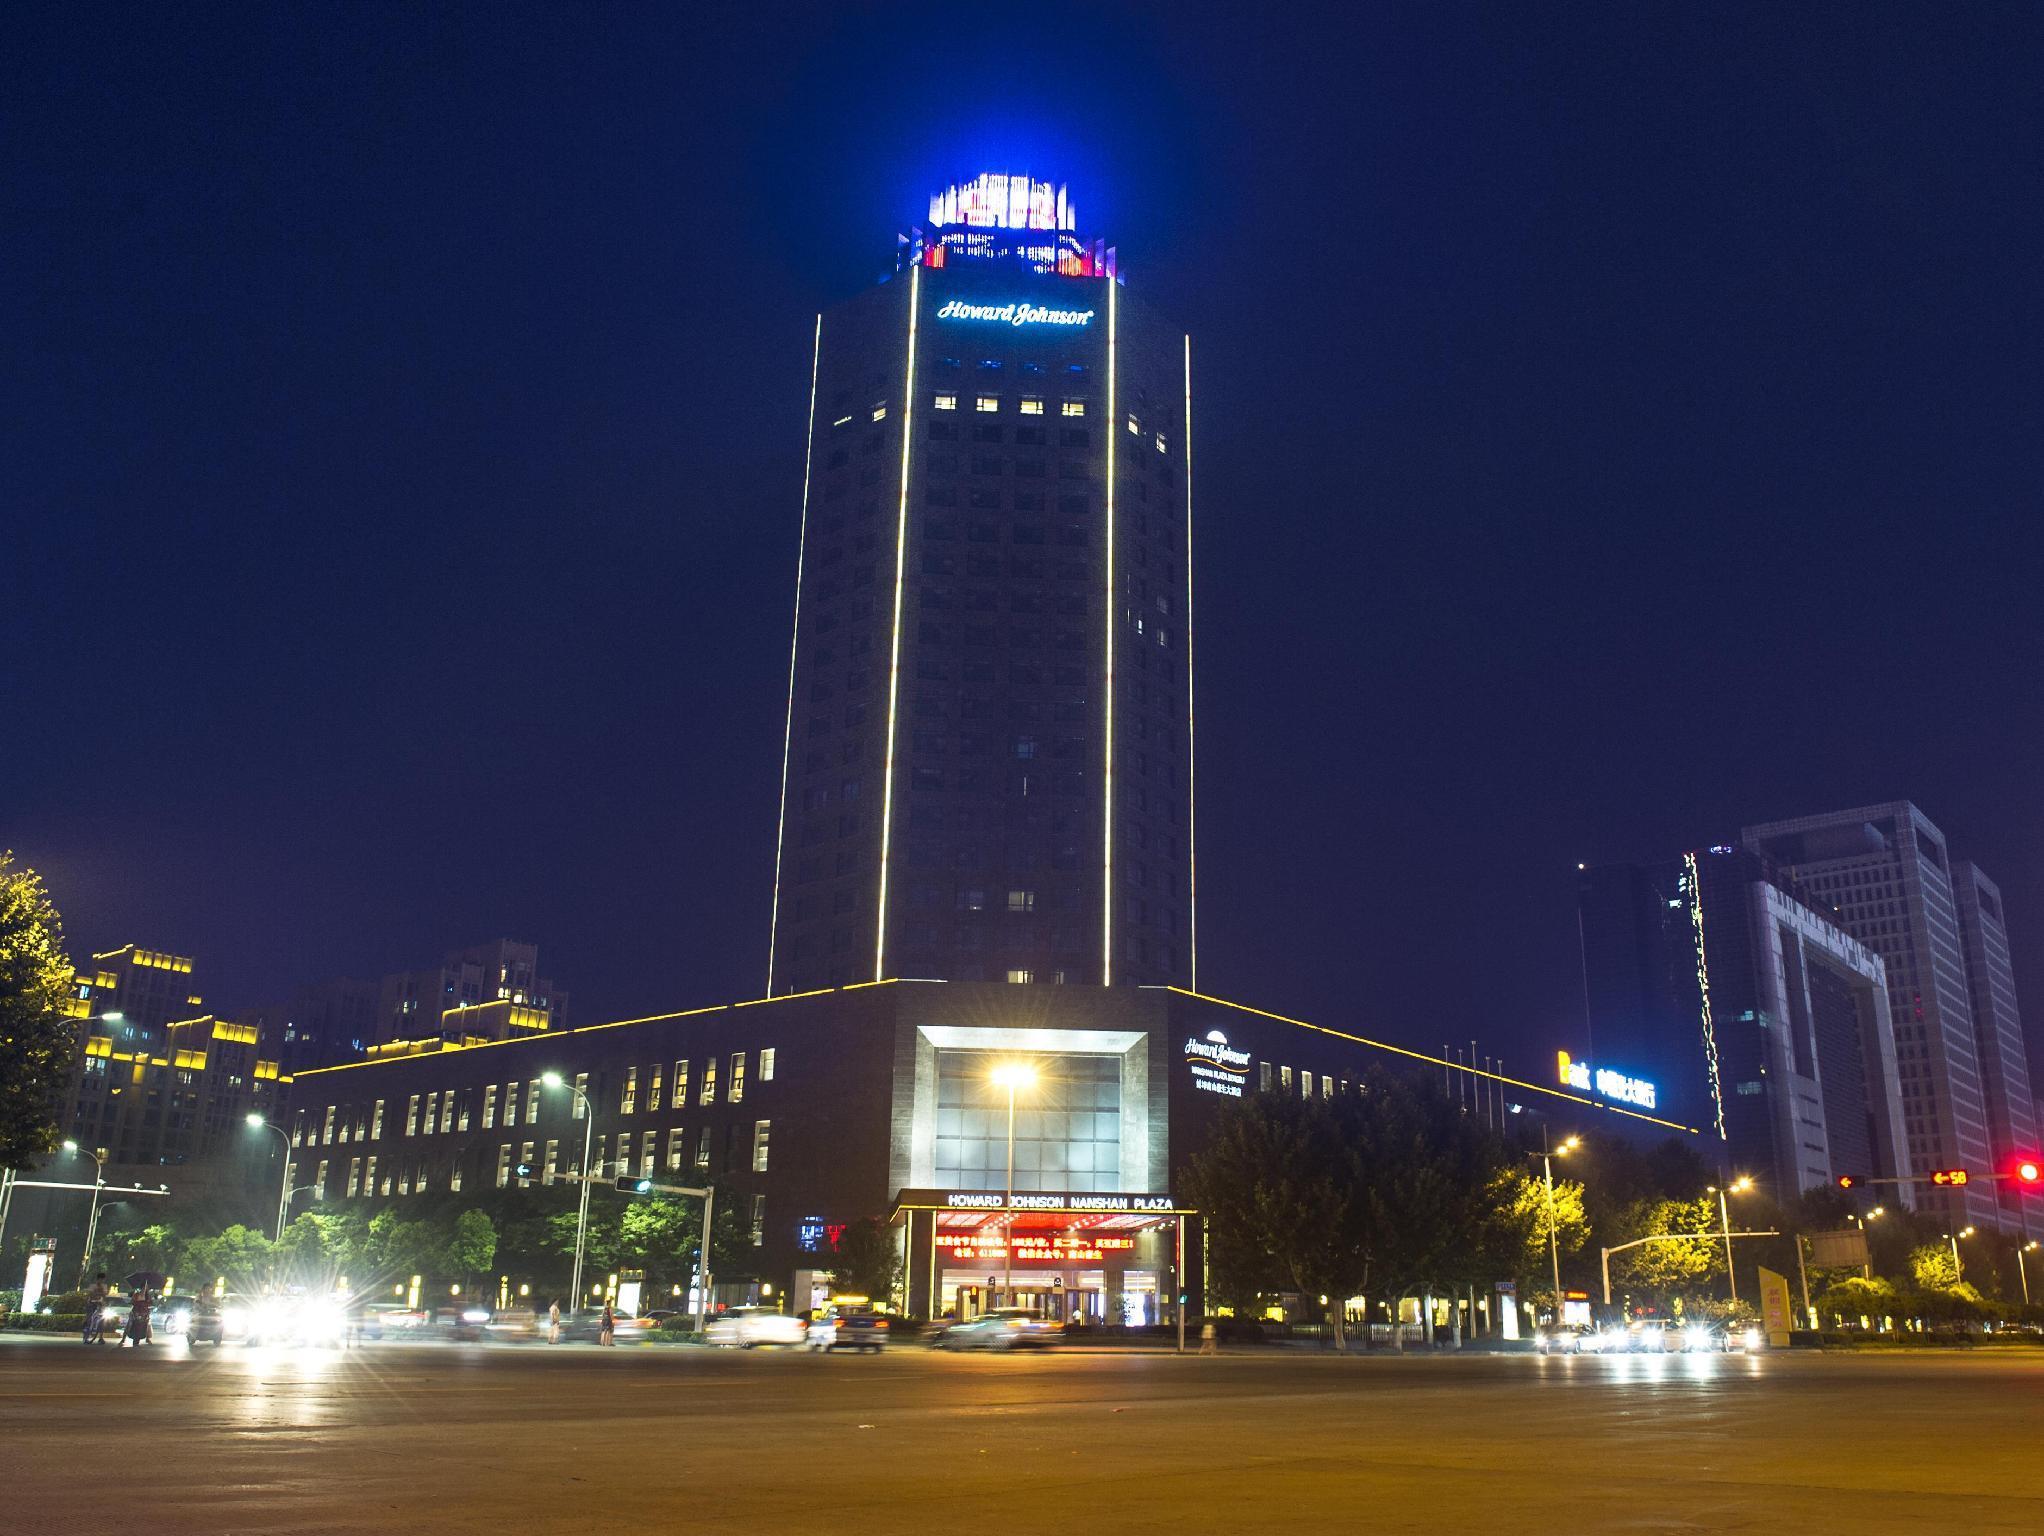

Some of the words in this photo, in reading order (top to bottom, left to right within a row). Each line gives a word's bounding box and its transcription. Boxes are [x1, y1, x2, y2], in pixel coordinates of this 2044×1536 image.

[937, 300, 1015, 321] Howard
[1012, 303, 1091, 326] Johnson
[948, 1194, 1003, 1207] HOWARD
[1009, 1195, 1064, 1209] JOHNSON
[1070, 1196, 1128, 1209] NANSHAN
[1133, 1198, 1173, 1210] PLAZA
